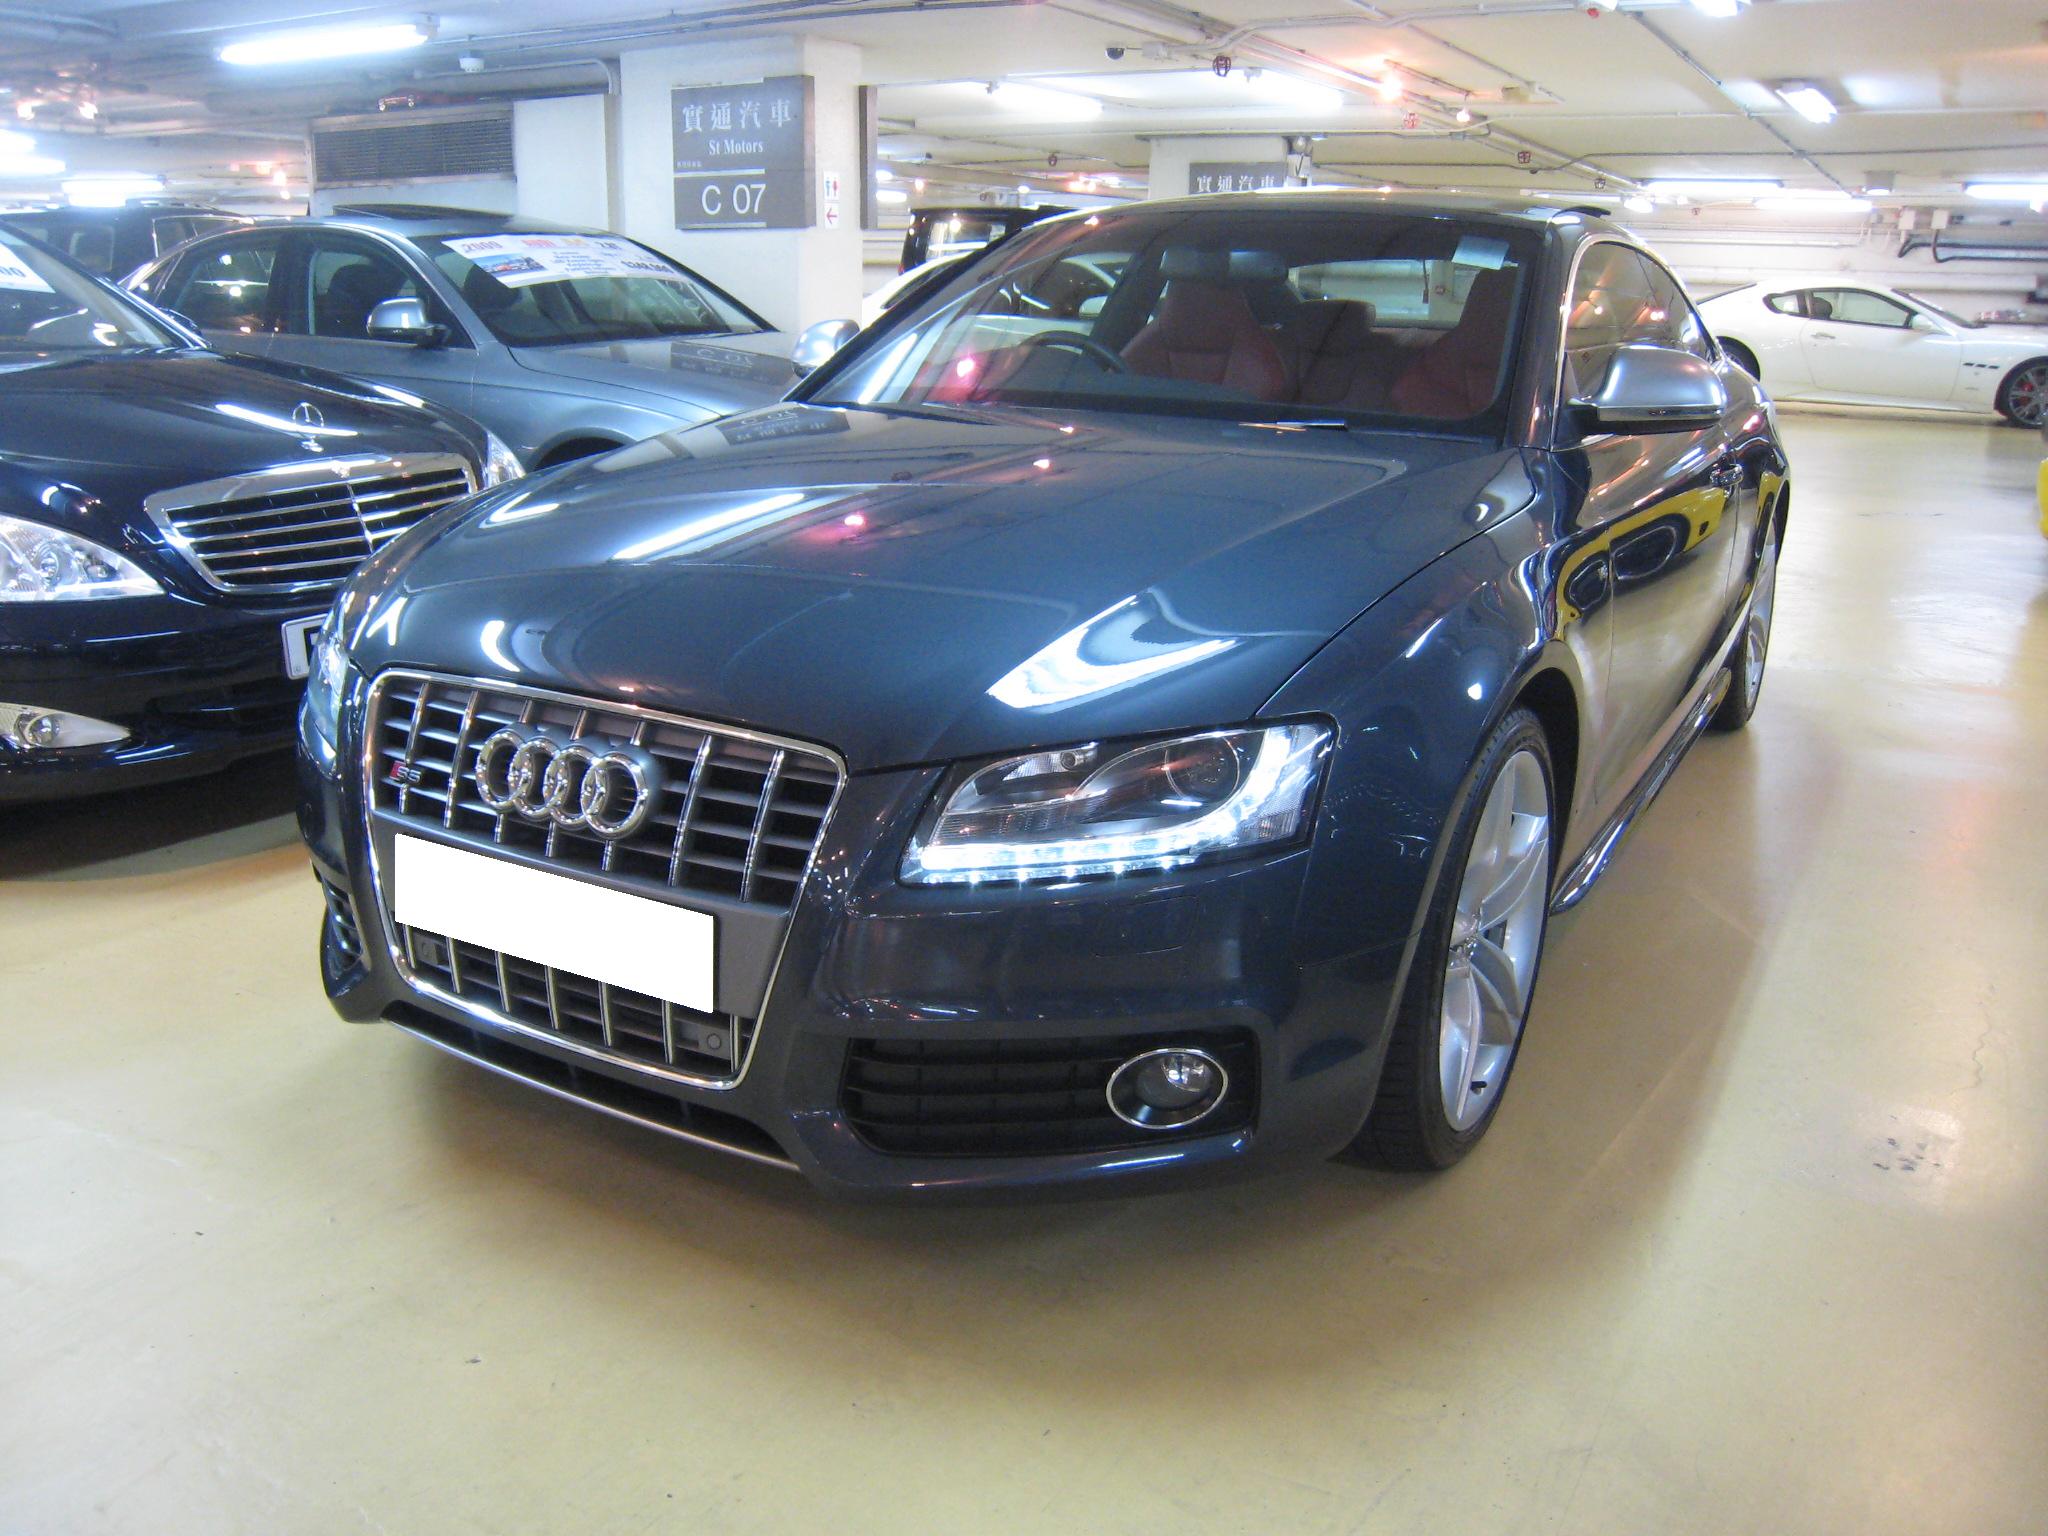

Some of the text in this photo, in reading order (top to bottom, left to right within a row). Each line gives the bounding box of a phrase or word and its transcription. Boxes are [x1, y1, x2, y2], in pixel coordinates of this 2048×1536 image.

[709, 139, 764, 155] St Motors
[702, 183, 766, 215] C 07
[397, 765, 421, 783] S5
